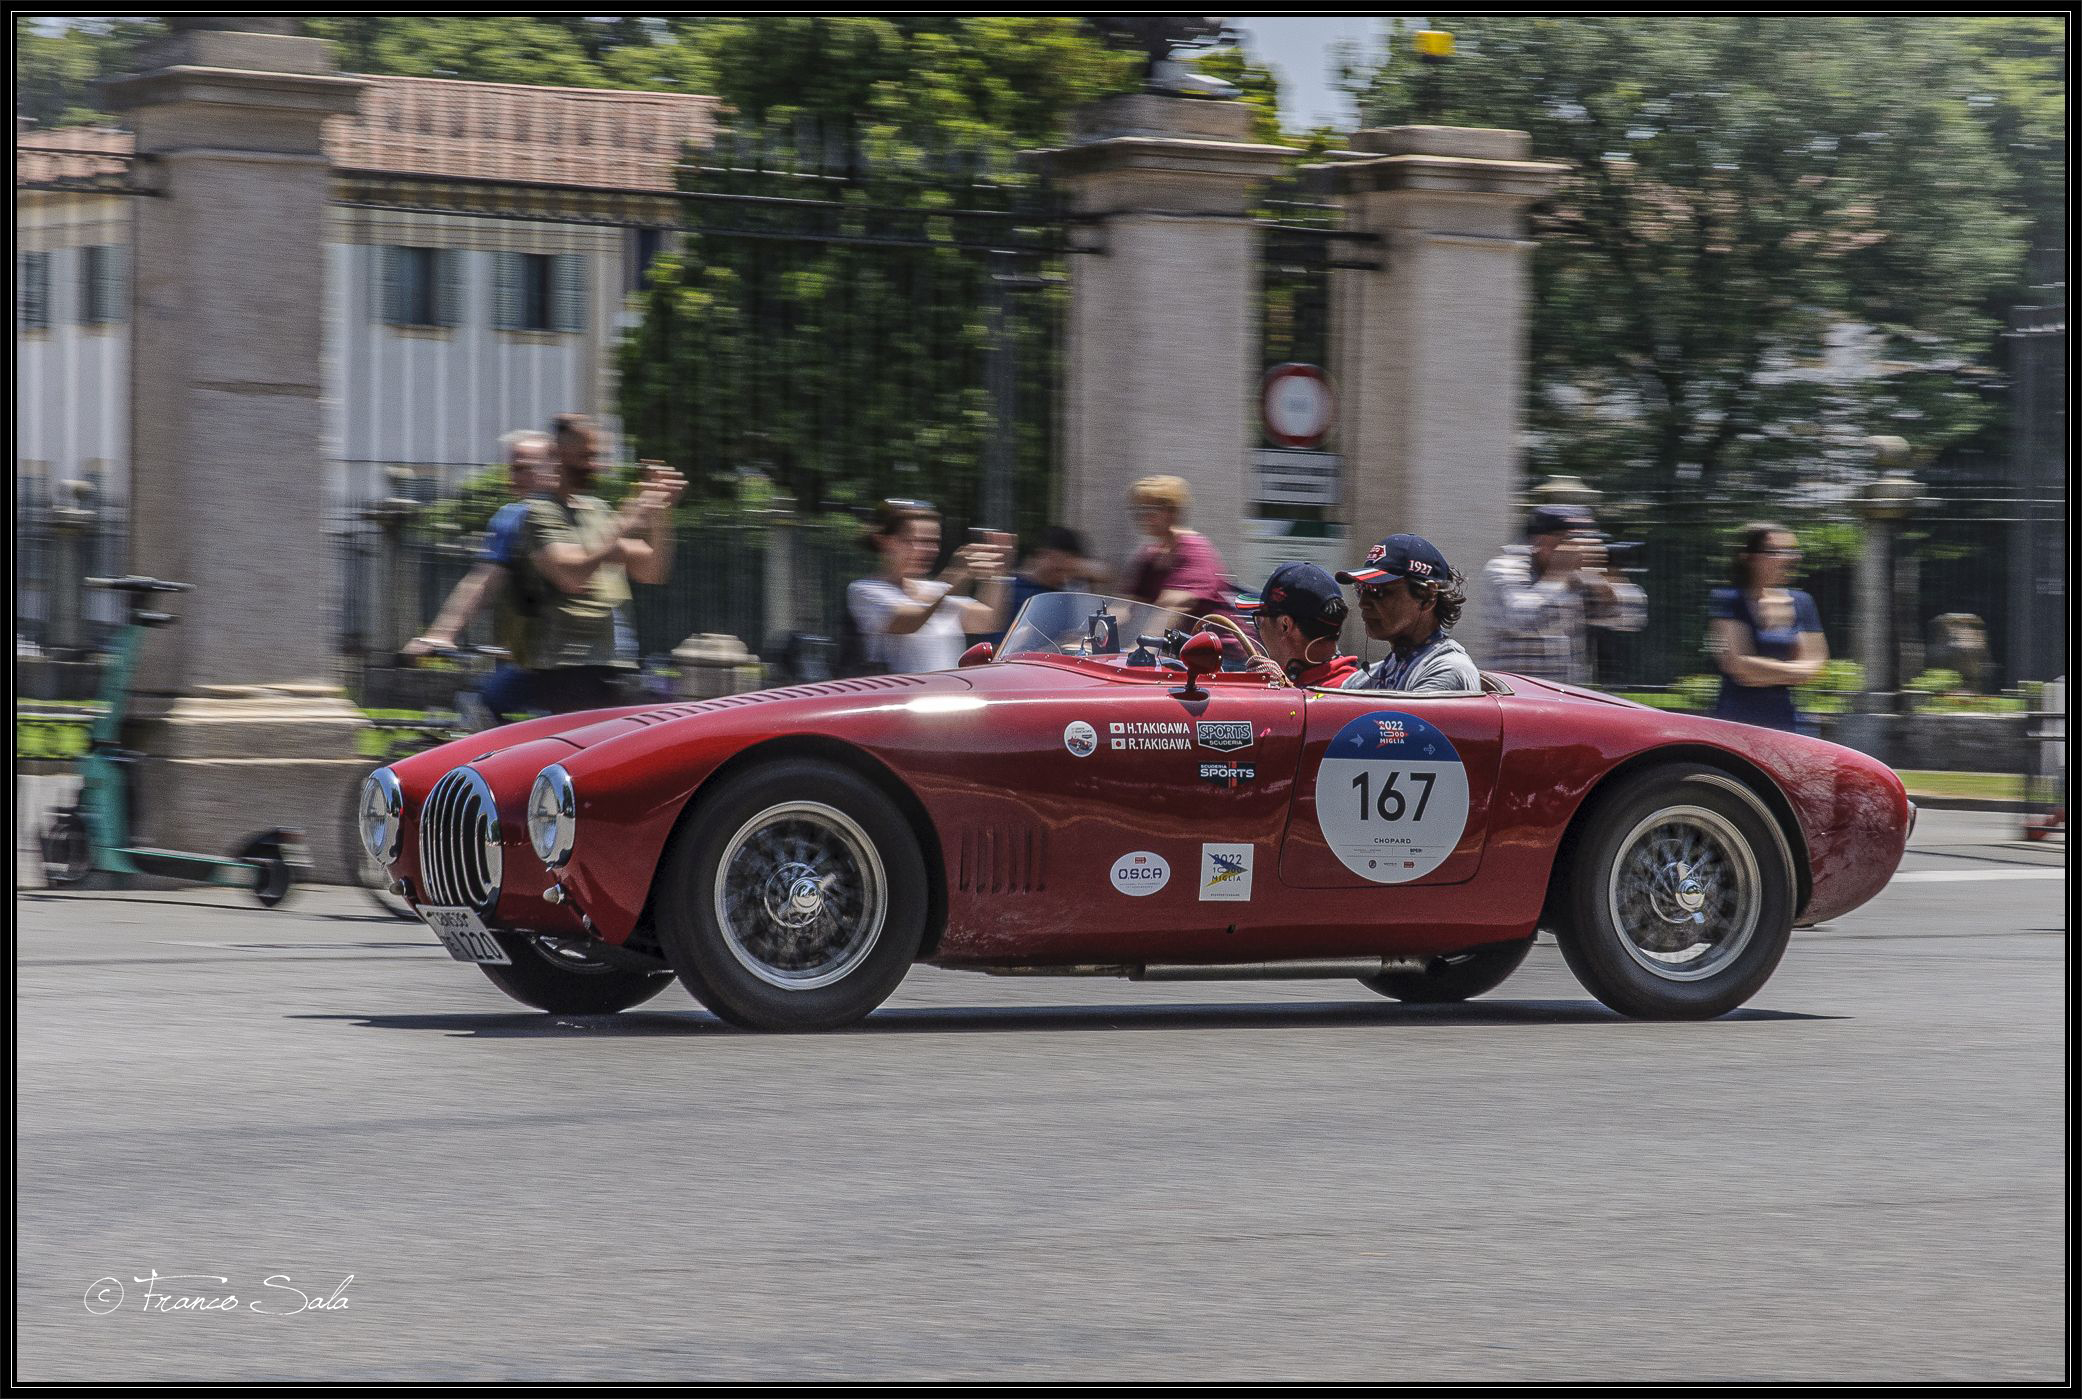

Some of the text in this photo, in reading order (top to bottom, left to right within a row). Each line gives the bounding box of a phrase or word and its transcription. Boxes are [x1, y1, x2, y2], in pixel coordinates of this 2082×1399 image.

[1408, 560, 1433, 576] 1927
[1127, 723, 1190, 734] H.TAKIGAWA
[1200, 725, 1250, 739] SPORTS
[1379, 721, 1403, 731] 2022
[1129, 738, 1191, 750] R.TAKIGAWA
[1200, 768, 1255, 778] SPORTS
[1352, 771, 1437, 822] 167
[1213, 854, 1242, 865] 2022
[451, 931, 503, 960] 1220
